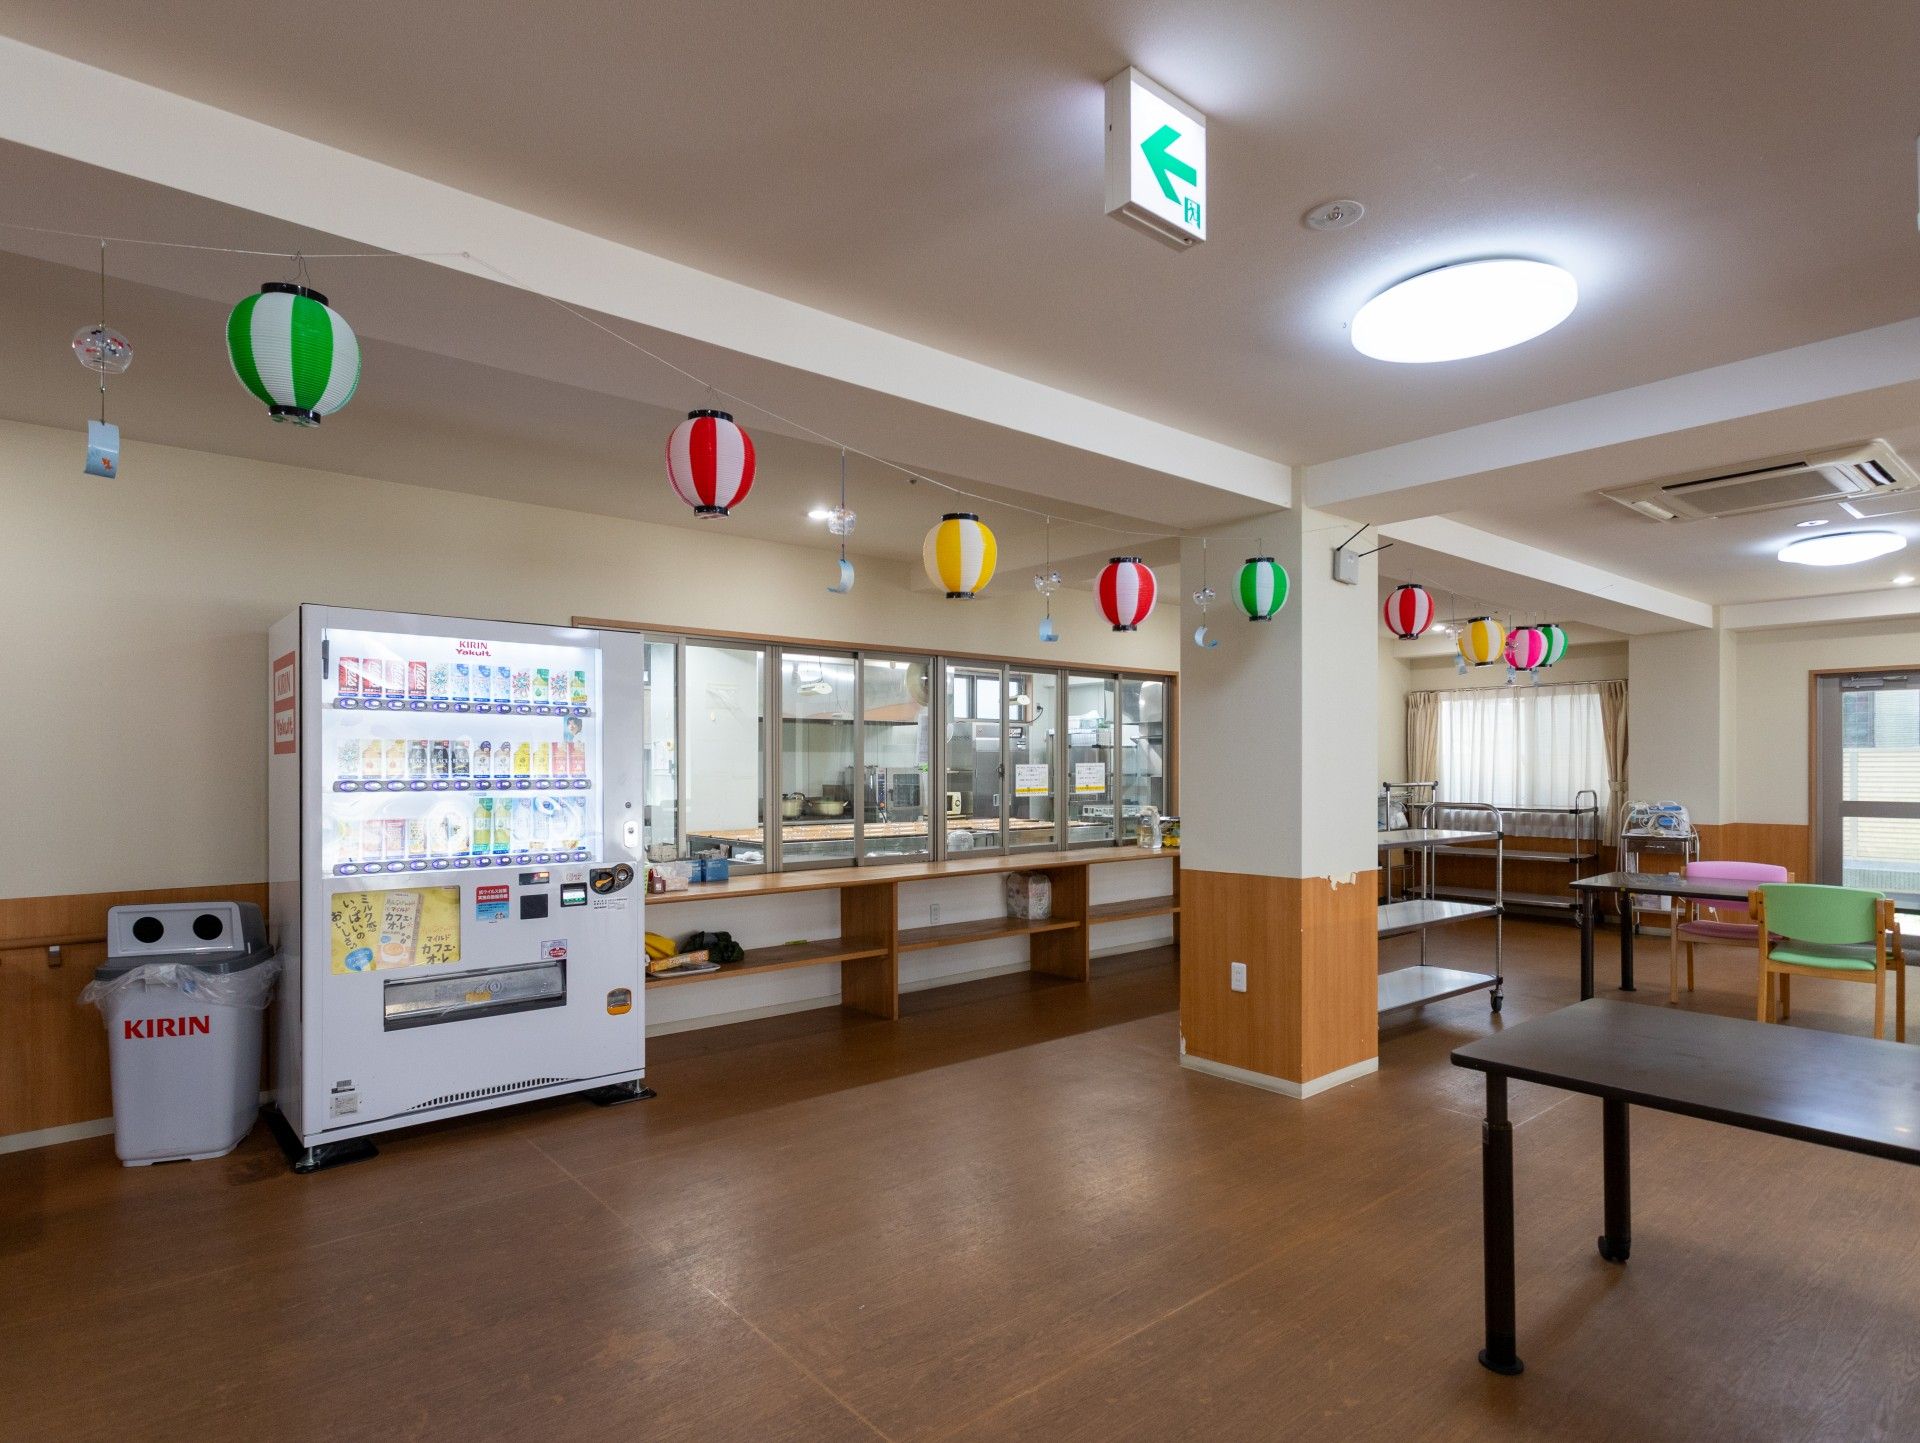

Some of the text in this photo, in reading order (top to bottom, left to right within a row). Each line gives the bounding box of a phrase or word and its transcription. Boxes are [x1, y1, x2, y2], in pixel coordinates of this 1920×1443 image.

[455, 648, 492, 657] Yakult
[459, 640, 488, 650] KIRIN
[342, 899, 366, 940] いっぱいの
[124, 1015, 210, 1040] KIRIN
